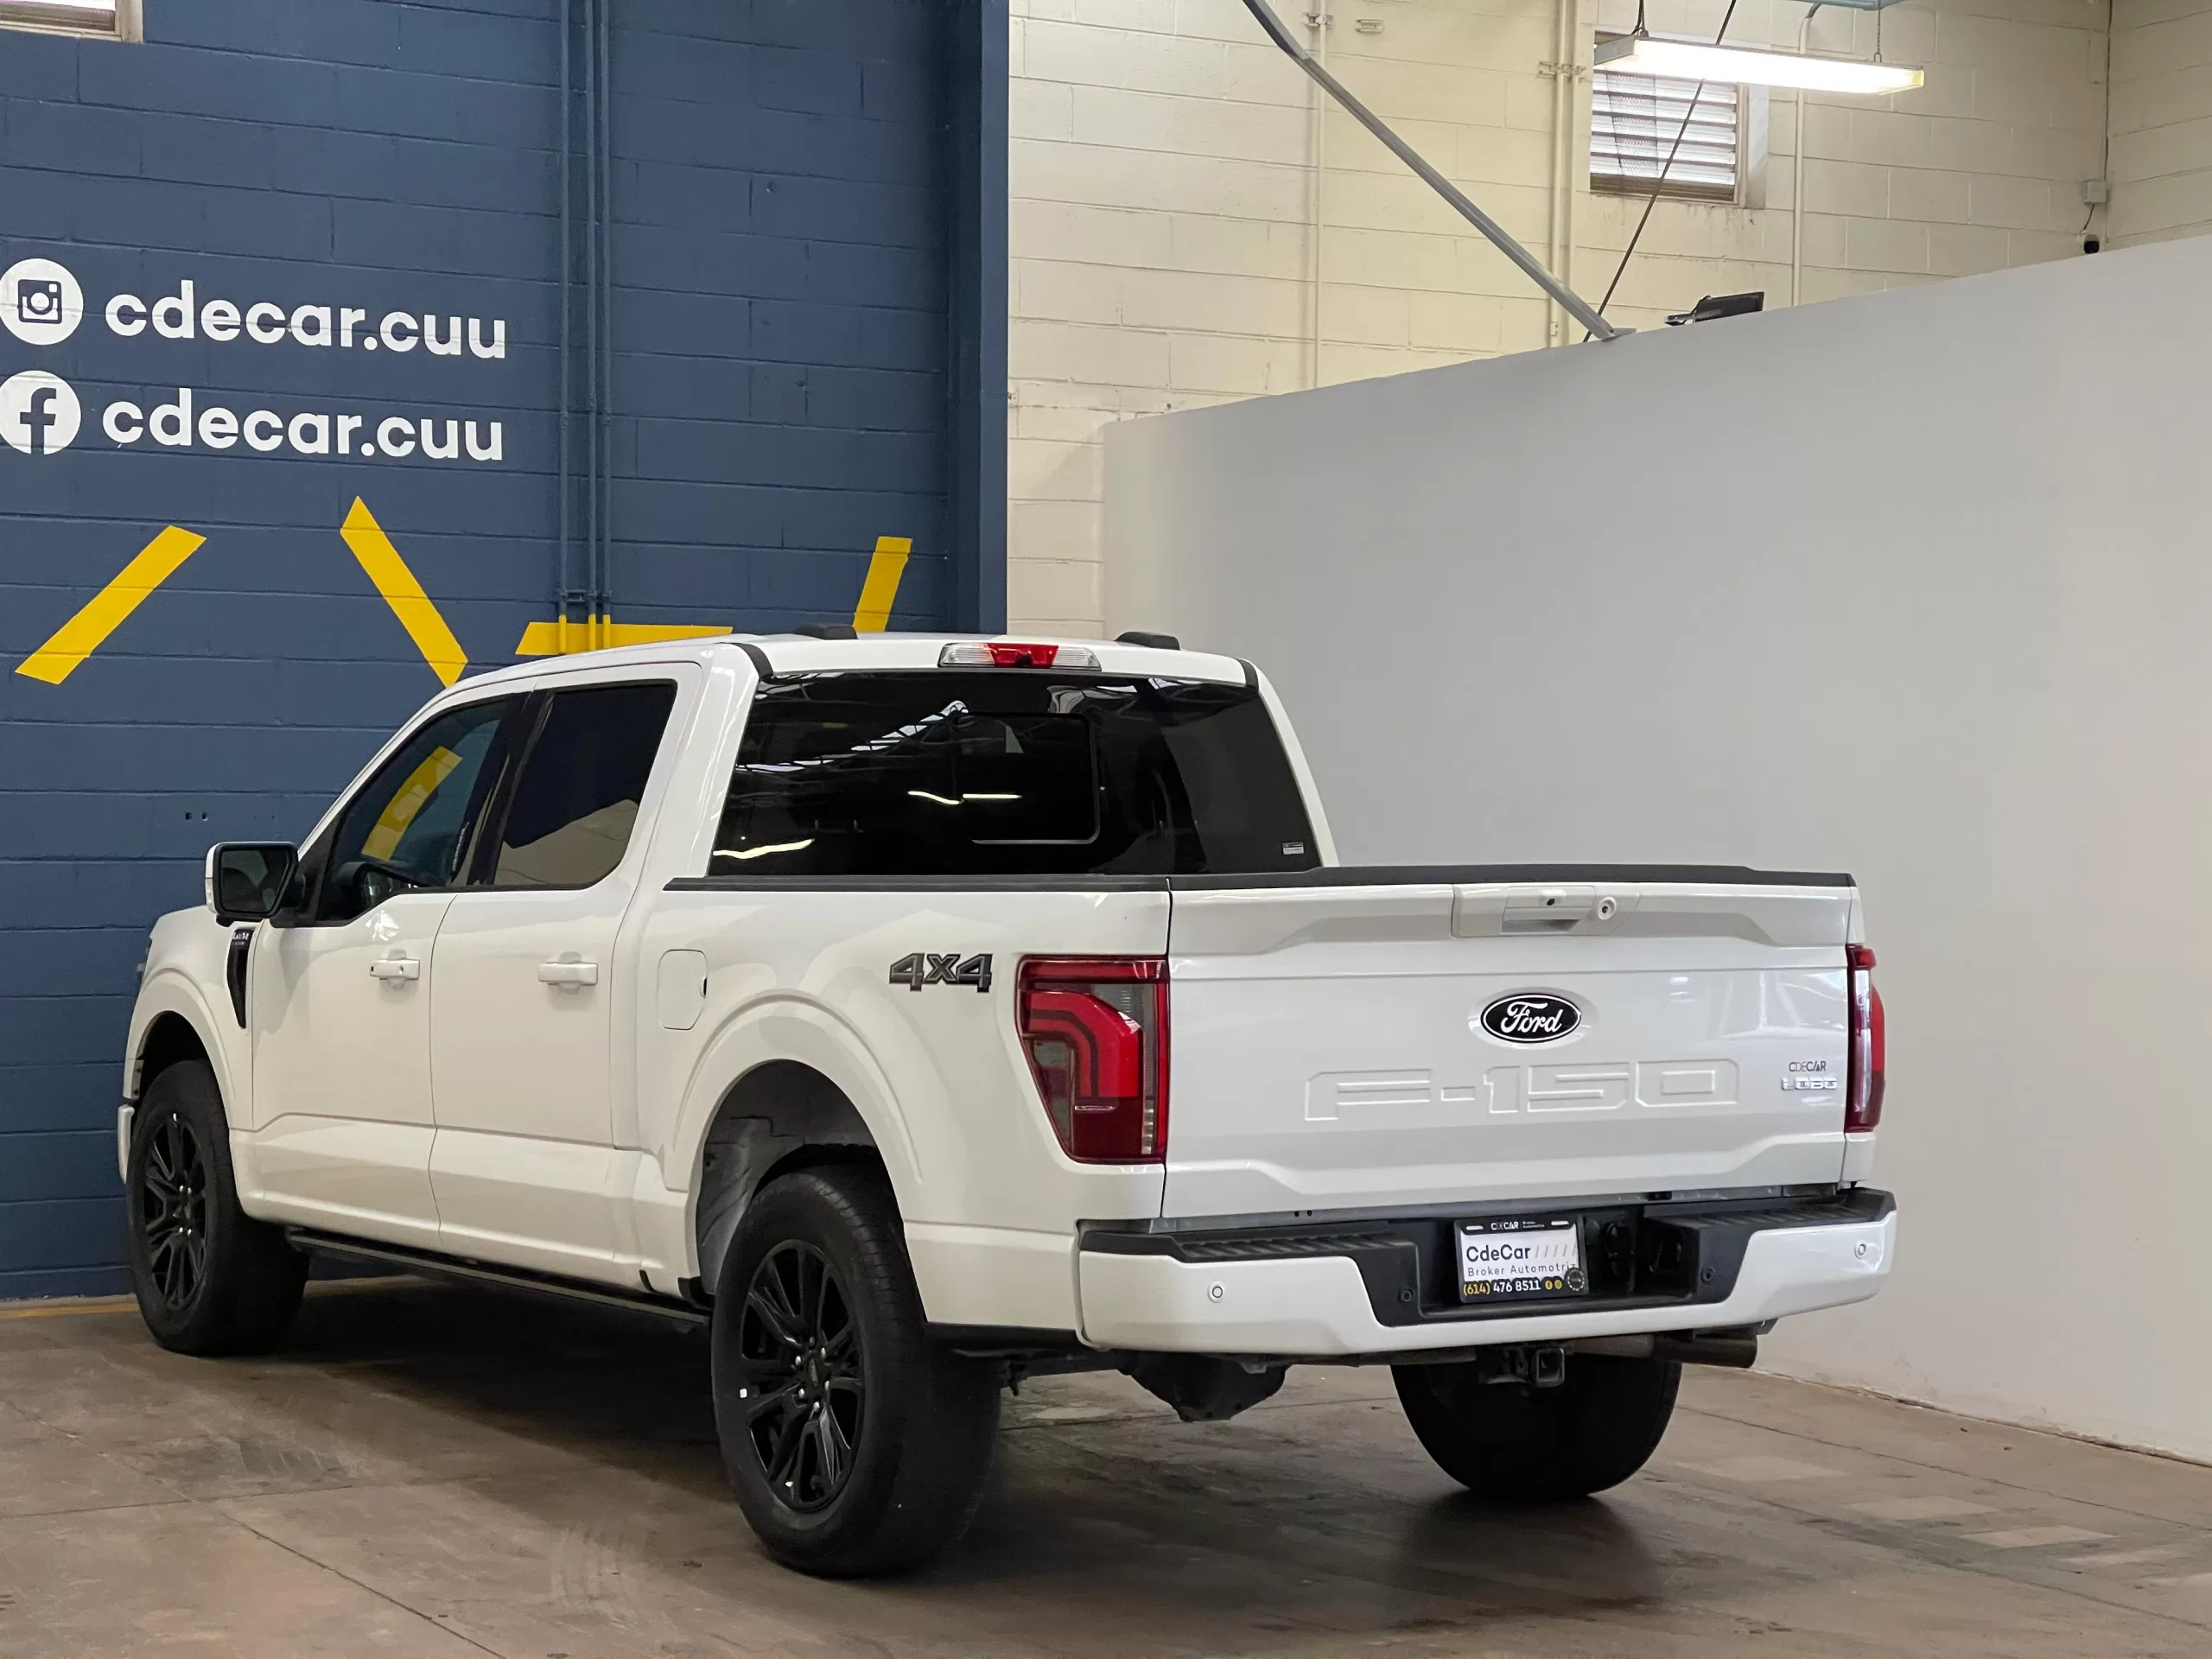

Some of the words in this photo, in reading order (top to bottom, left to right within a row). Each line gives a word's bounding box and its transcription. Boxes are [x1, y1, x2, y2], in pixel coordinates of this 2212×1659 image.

[105, 279, 506, 359] cdecar.cuu
[102, 387, 503, 461] cdecar.cuu
[1500, 1001, 1562, 1034] Ford
[1305, 1058, 1740, 1121] F-150
[1465, 1244, 1531, 1262] CdeCar
[1463, 1282, 1491, 1296] (614)
[1493, 1281, 1513, 1293] 476
[1515, 1280, 1541, 1291] 8511
[1467, 1266, 1505, 1277] Broker
